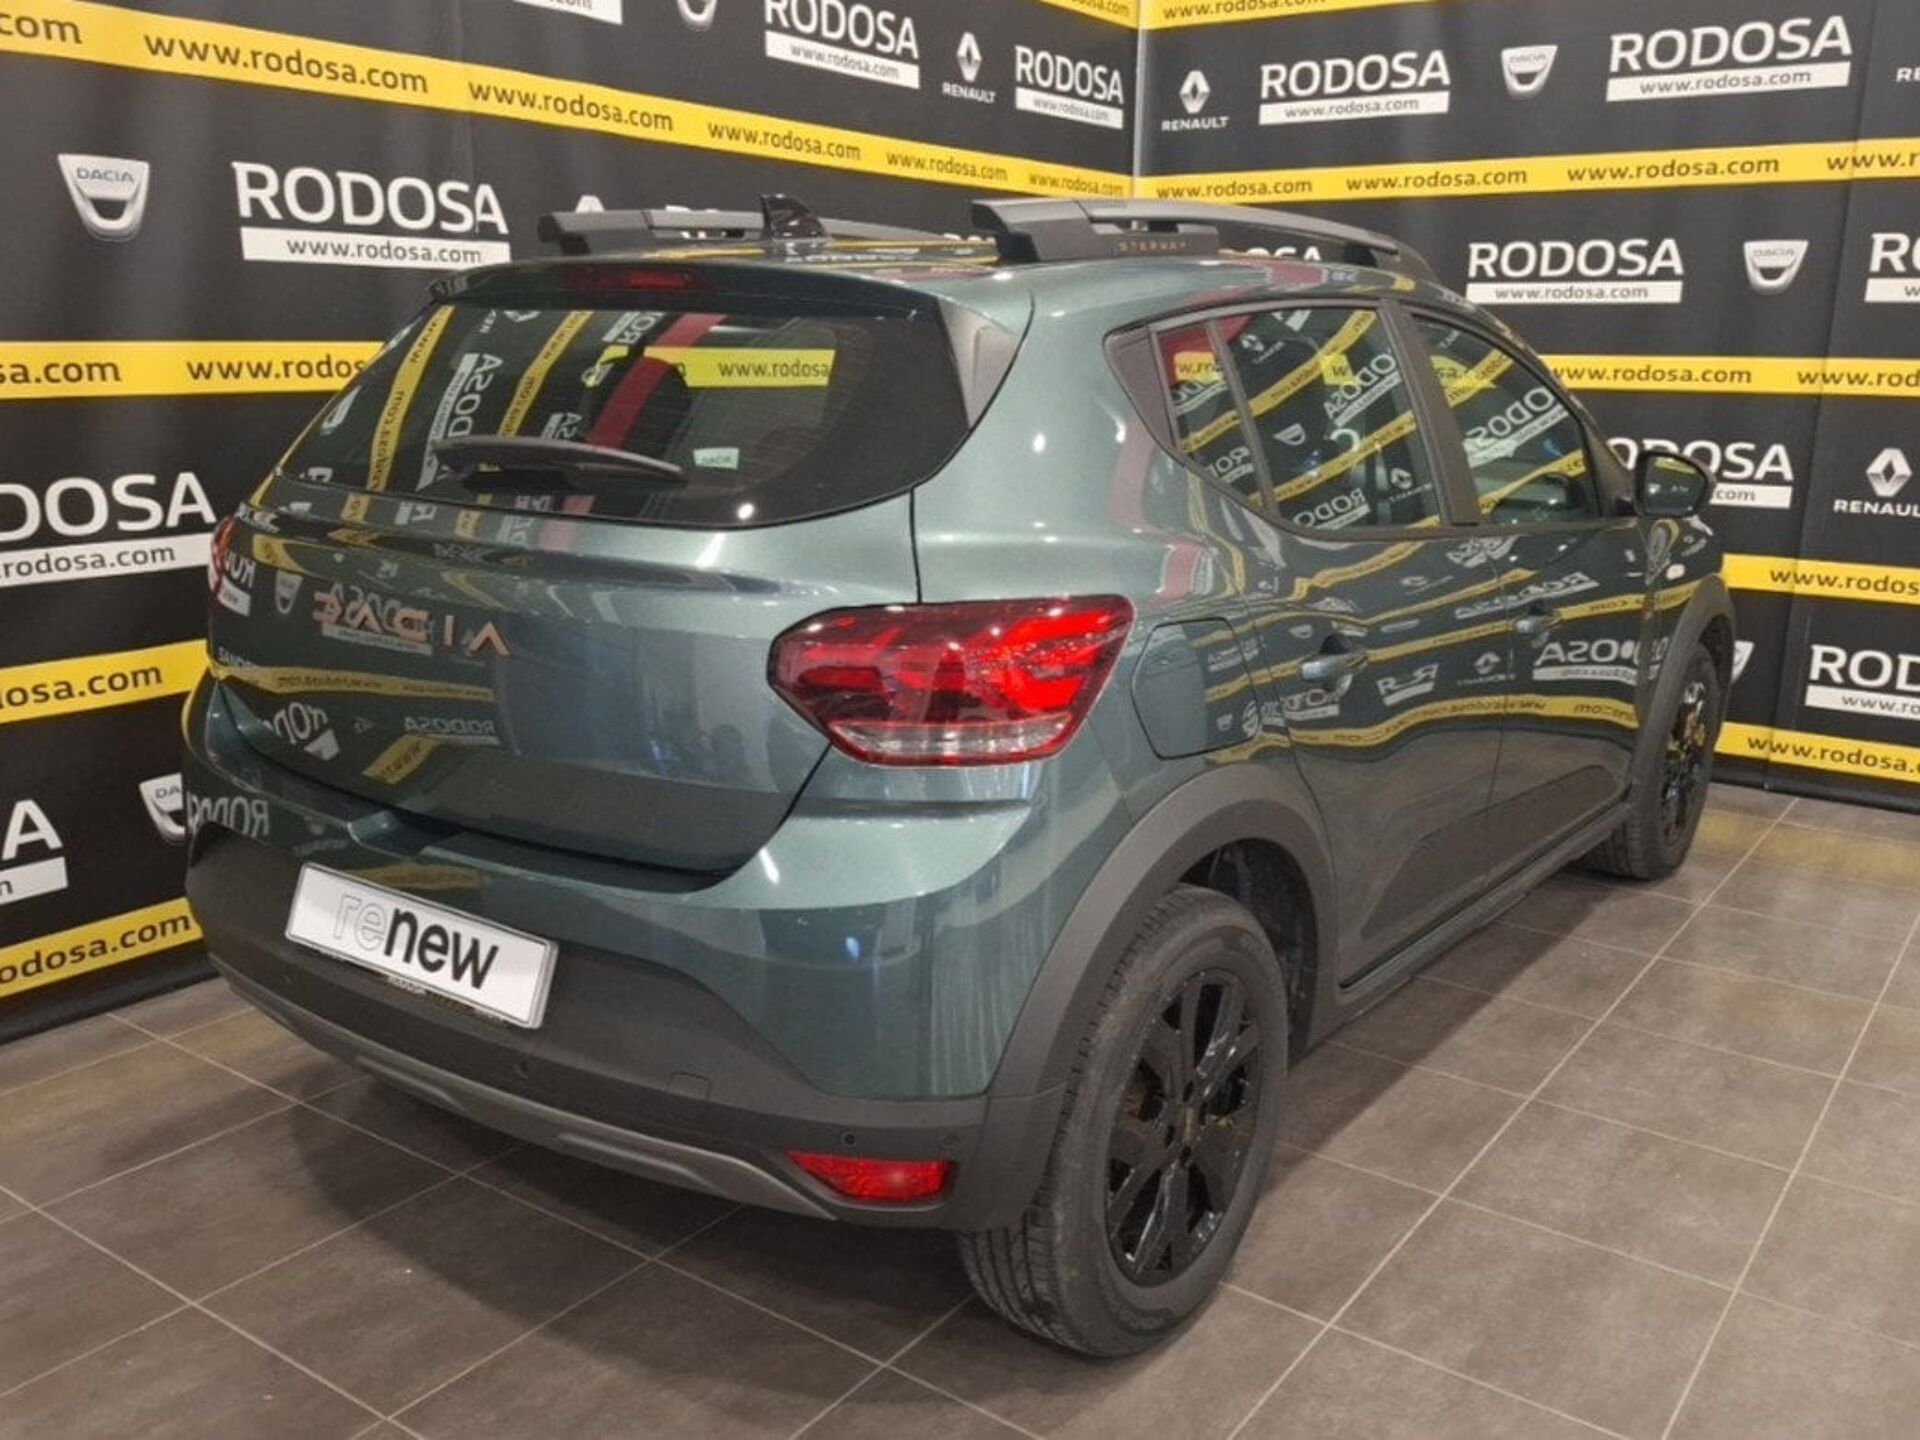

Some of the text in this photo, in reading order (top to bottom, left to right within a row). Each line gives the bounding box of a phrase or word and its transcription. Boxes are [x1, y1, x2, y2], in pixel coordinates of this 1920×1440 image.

[764, 0, 919, 59] RODOSA
[1610, 15, 1852, 73] RODOSA
[144, 31, 429, 95] www.rodosa.com
[790, 44, 900, 79] www.rodosa.com
[1014, 45, 1124, 104] RODOSA
[1260, 50, 1451, 99] RODOSA
[942, 82, 997, 103] RENAULT
[1640, 69, 1812, 94] www.rodosa.com
[468, 81, 674, 131] www.rodosa.com
[1285, 97, 1419, 118] www.rodosa.com
[1161, 116, 1230, 131] RENAULT
[708, 121, 861, 160] www.rodosa.com
[77, 167, 134, 184] DACIA
[887, 150, 1008, 181] www.rodosa.com
[1346, 167, 1527, 191] www.rodosa.com
[1567, 156, 1780, 182] www.rodosa.com
[231, 161, 508, 234] RODOSA
[1028, 172, 1123, 195] www.rodosa.com
[1156, 180, 1313, 199] www.rodosa.com
[287, 237, 482, 265] www.rodosa.com
[1468, 238, 1684, 278] RODOSA
[1495, 285, 1649, 300] www.rodosa.com
[332, 893, 500, 990] renew
